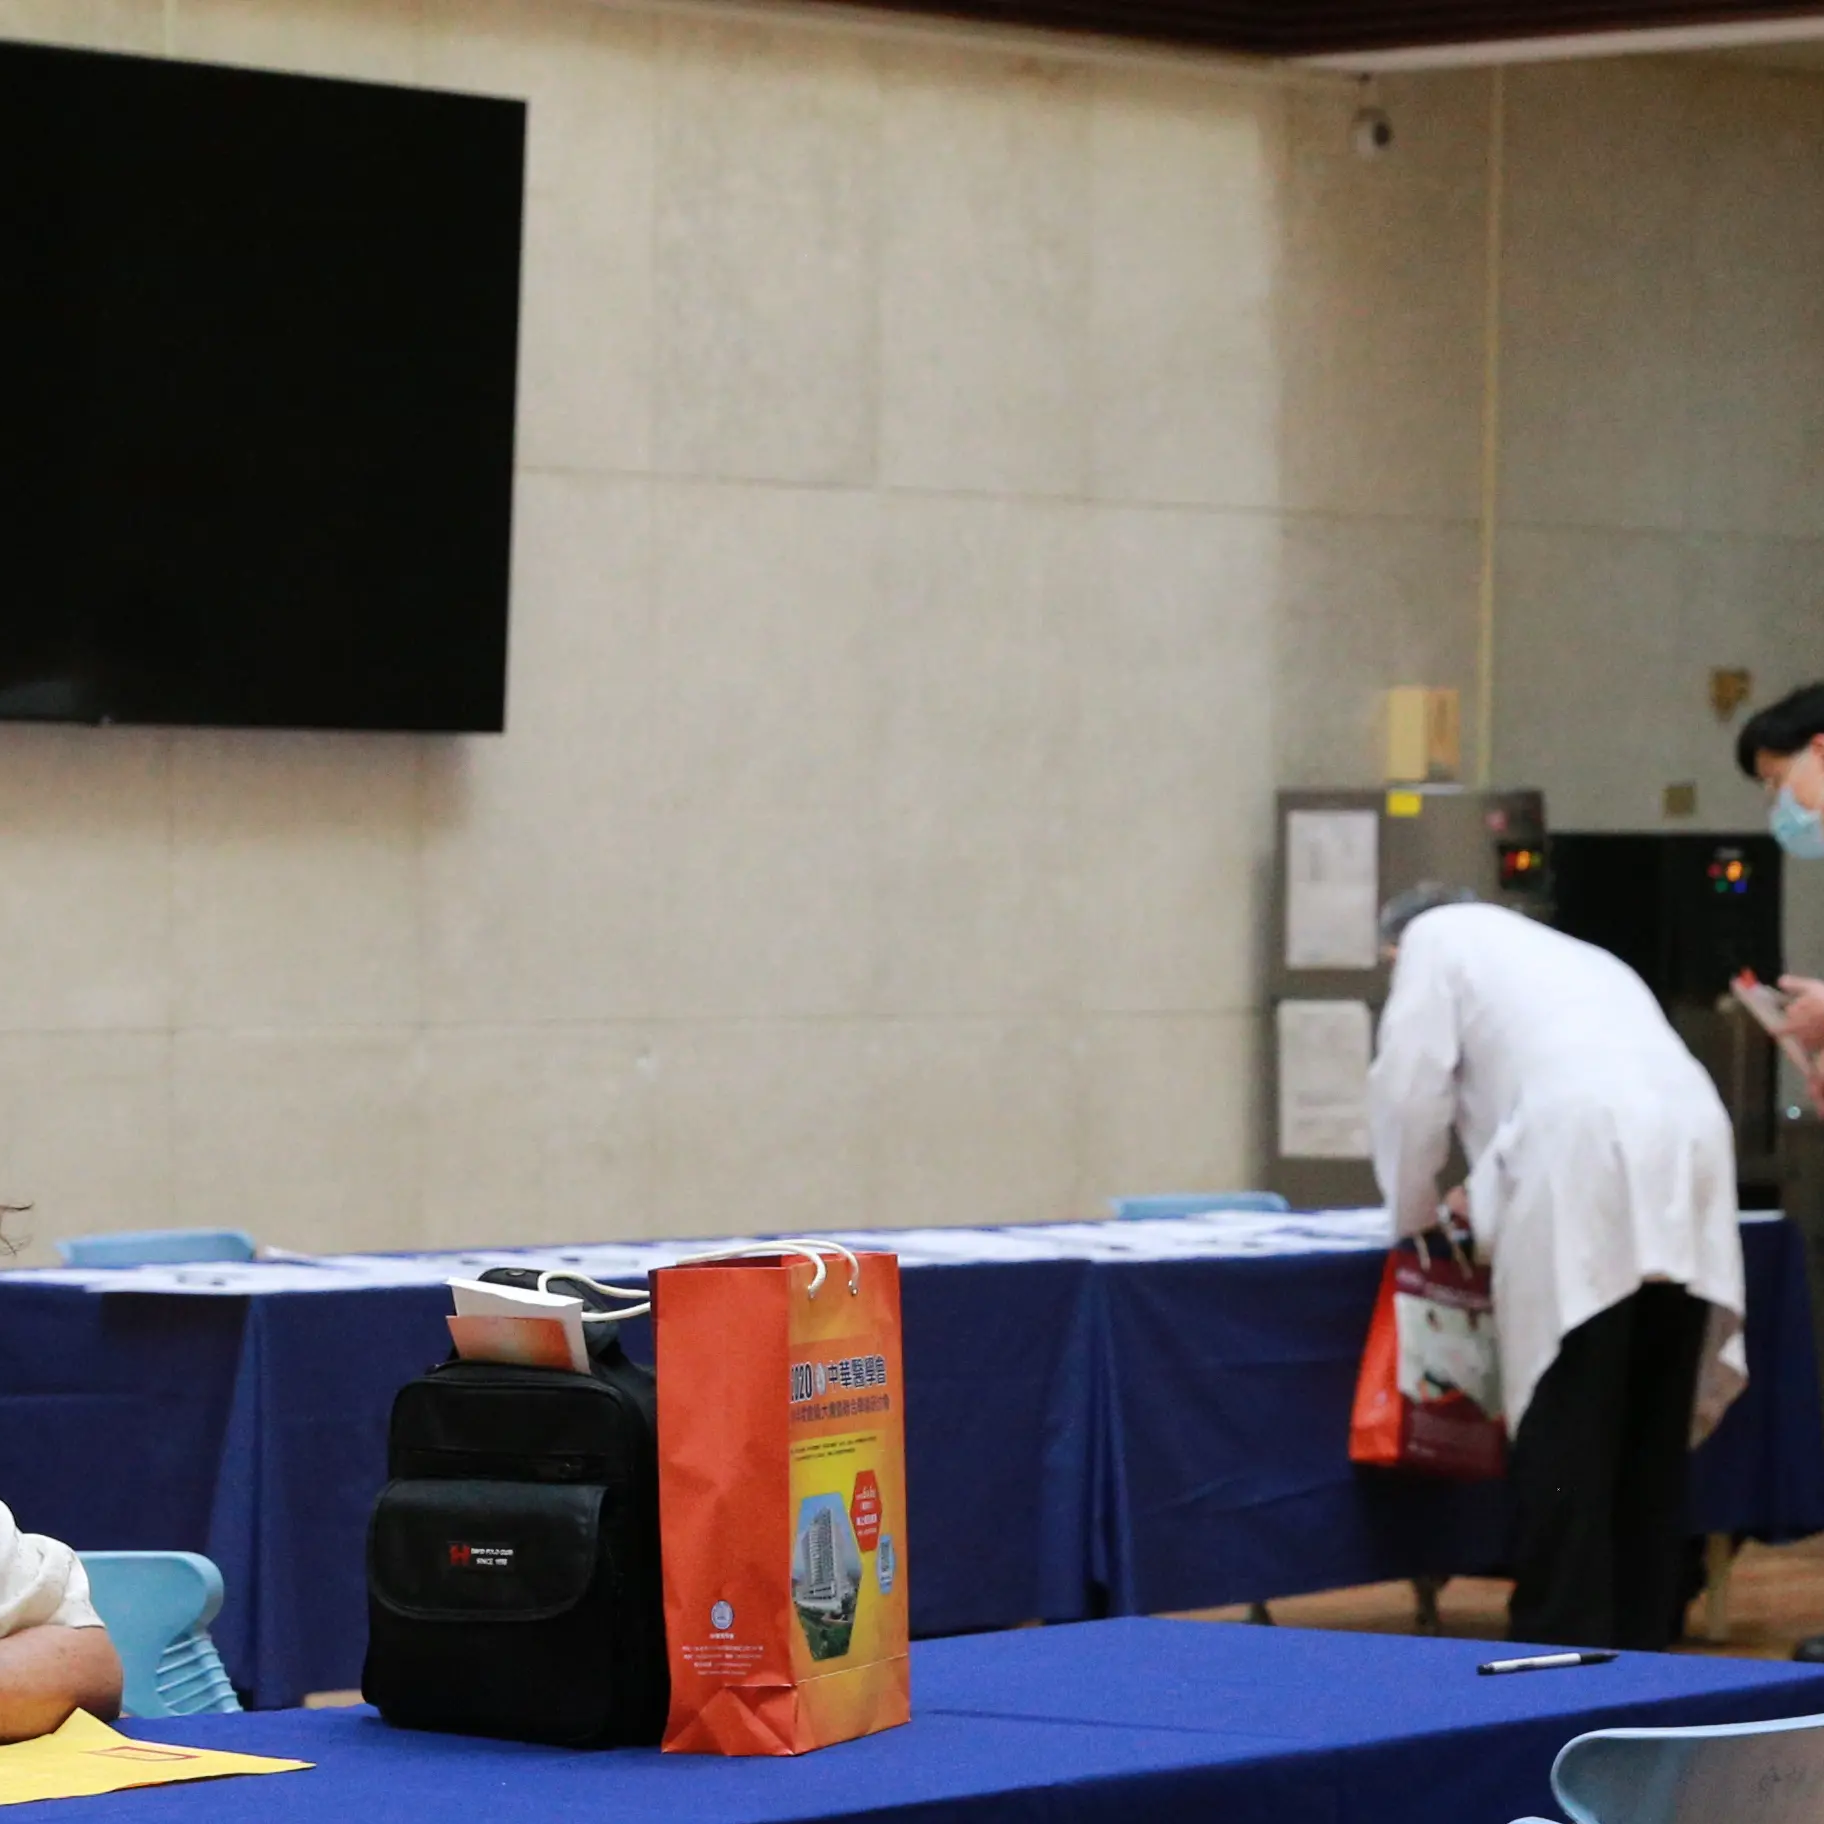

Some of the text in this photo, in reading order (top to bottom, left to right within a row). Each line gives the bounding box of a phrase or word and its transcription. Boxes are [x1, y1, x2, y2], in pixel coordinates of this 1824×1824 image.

[827, 1354, 886, 1391] 中華醫學會
